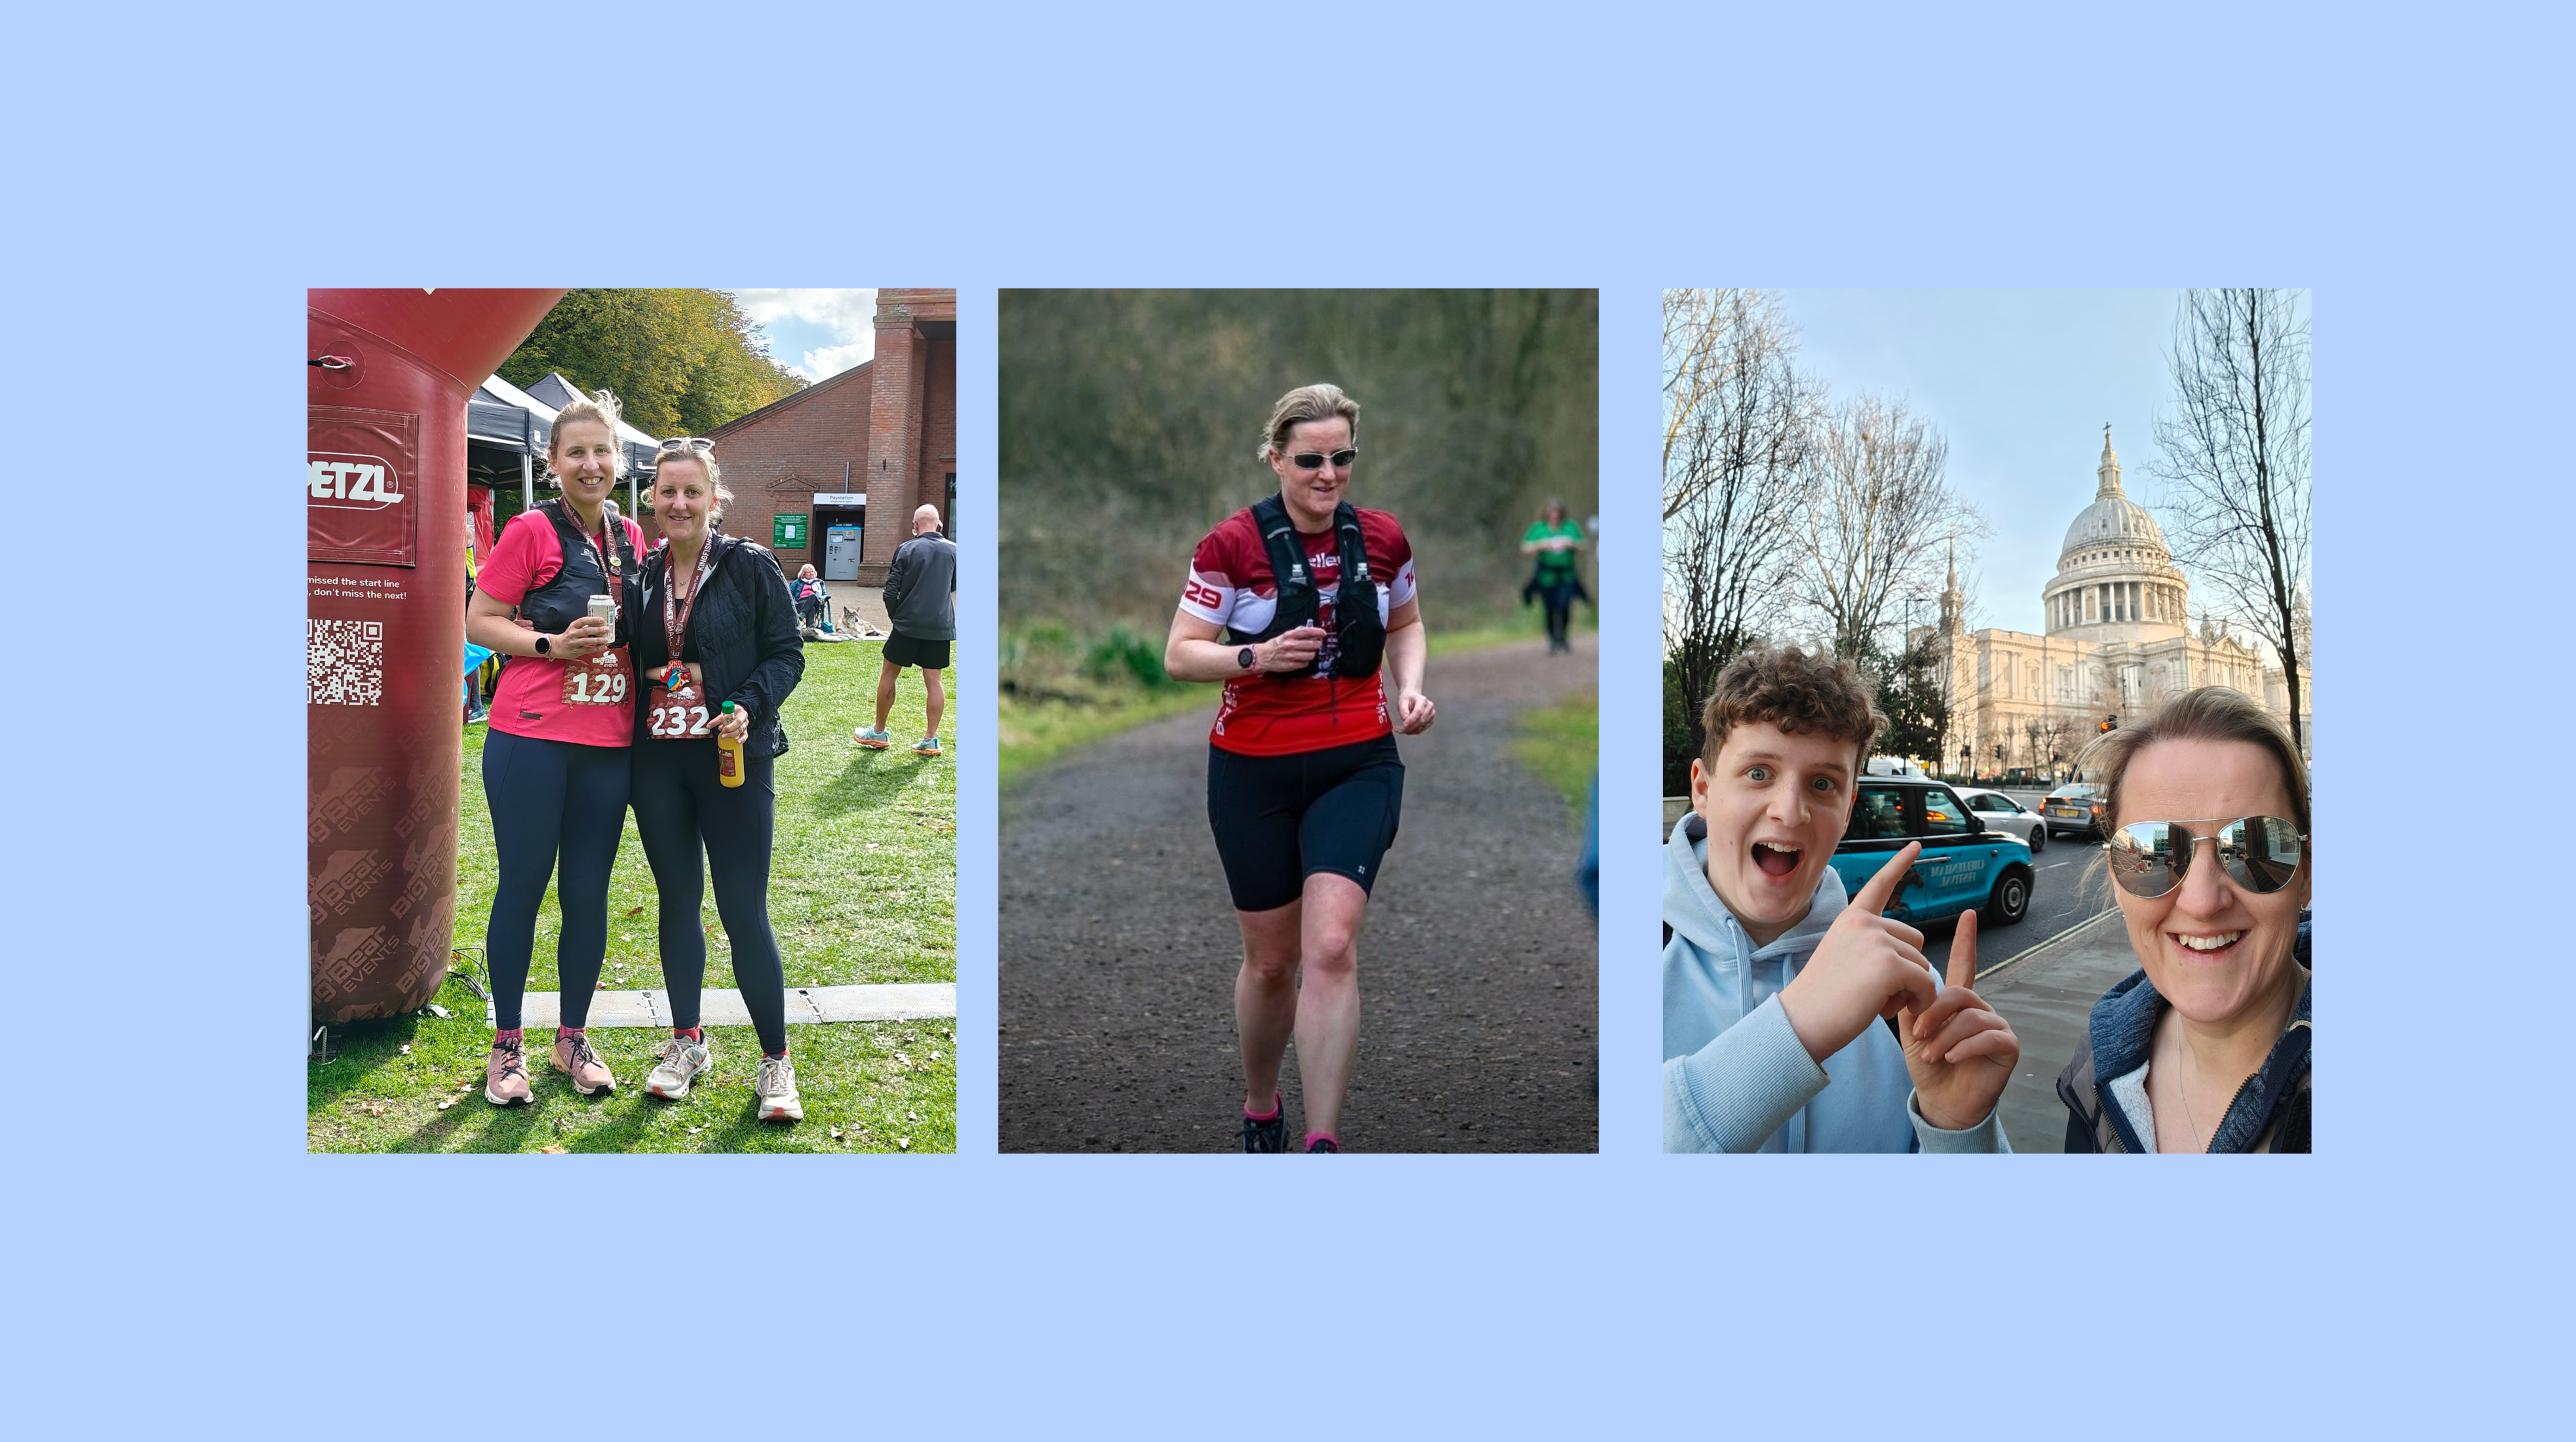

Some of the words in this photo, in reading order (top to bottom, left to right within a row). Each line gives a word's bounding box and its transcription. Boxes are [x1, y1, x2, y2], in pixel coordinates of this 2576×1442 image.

[604, 522, 616, 557] CHALLENG
[314, 588, 340, 596] don't
[342, 589, 364, 598] miss
[366, 589, 382, 599] the
[385, 591, 407, 600] next!
[342, 577, 357, 586] the
[359, 579, 381, 587] start
[384, 579, 400, 588] line
[1184, 579, 1222, 609] 29
[570, 672, 626, 703] 129
[652, 706, 711, 735] 232
[321, 766, 383, 825] Bear
[338, 777, 397, 834] EVENTS
[393, 796, 432, 839] Big
[317, 849, 380, 907] Bear
[334, 859, 394, 916] EVENTS
[389, 876, 428, 921] Big
[326, 925, 387, 984] Bear
[342, 935, 400, 994] EVENTS
[395, 950, 431, 995] Big
